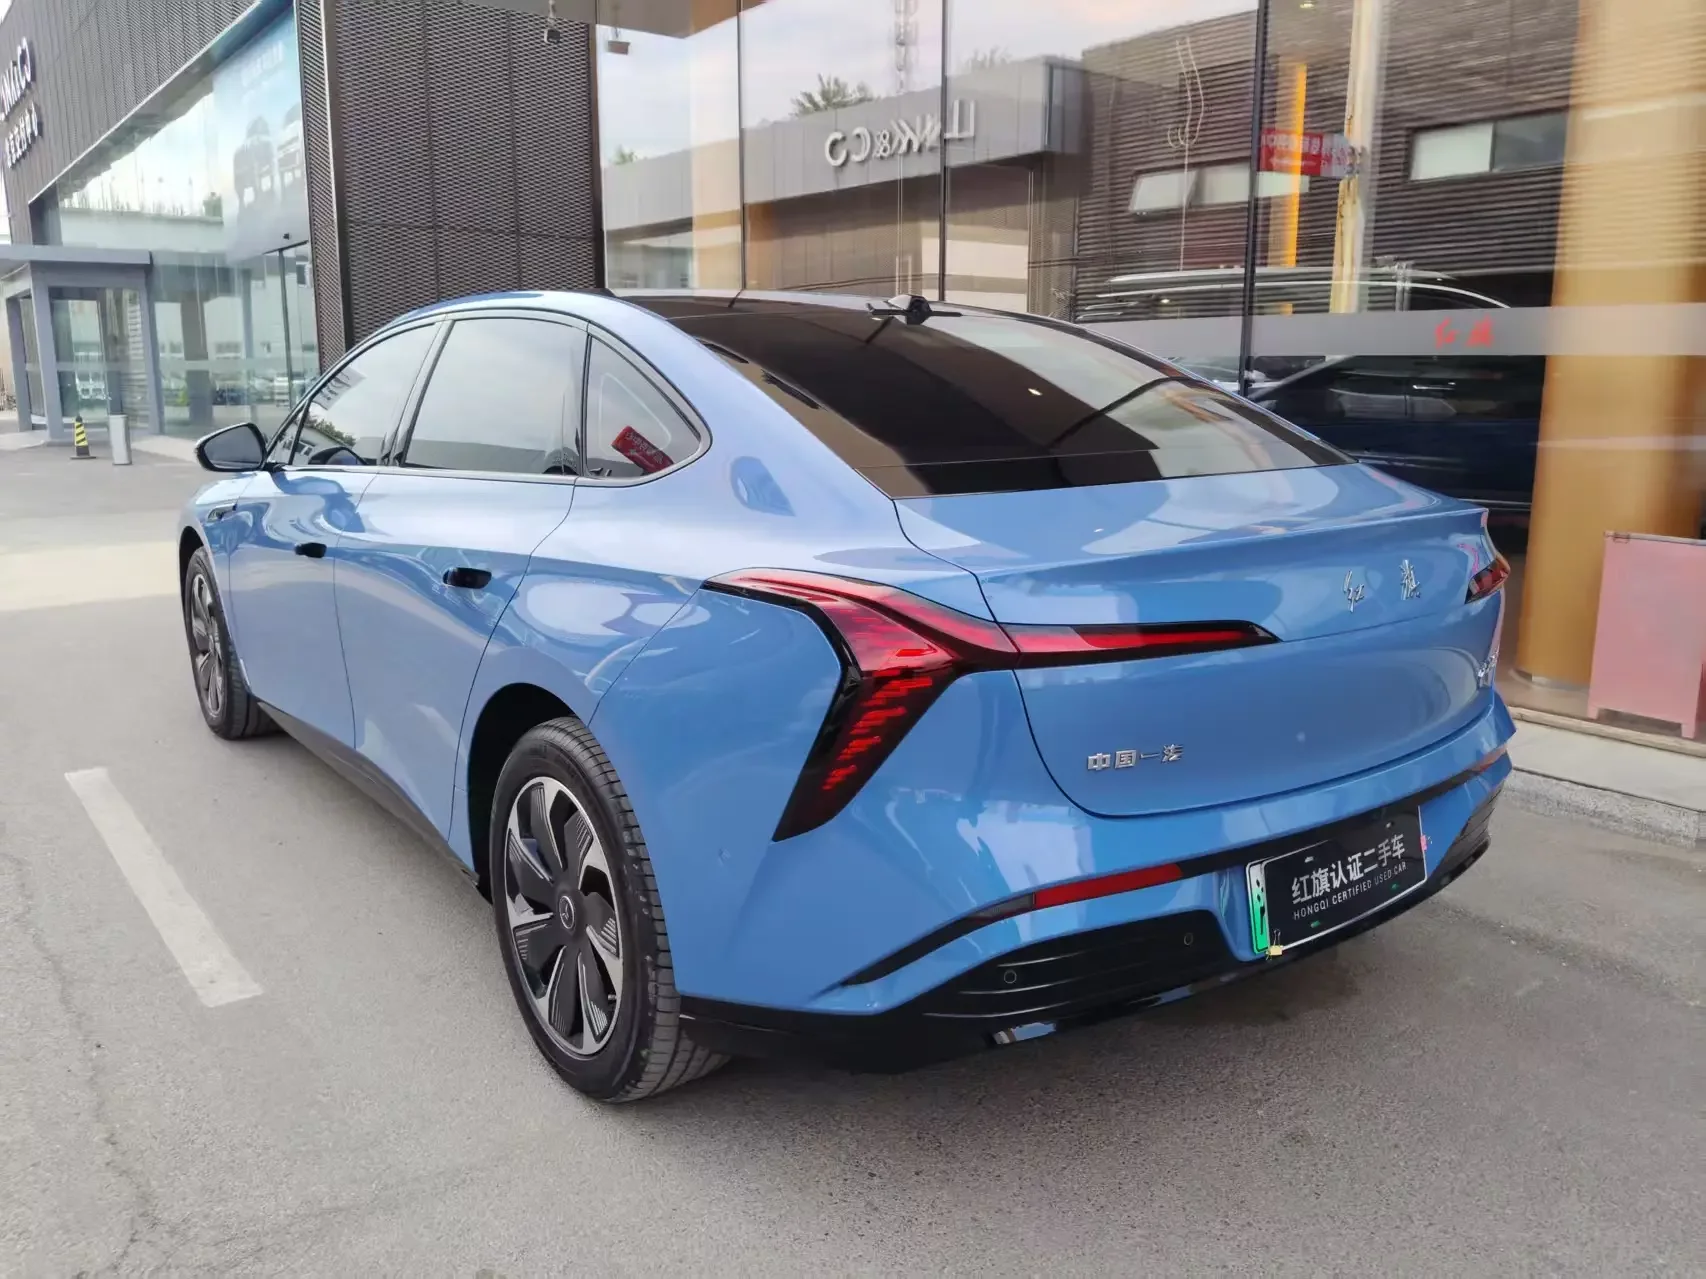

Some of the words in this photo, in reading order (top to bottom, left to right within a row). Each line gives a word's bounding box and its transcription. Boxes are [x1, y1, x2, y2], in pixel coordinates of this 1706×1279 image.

[1087, 743, 1184, 771] 中国一汽
[1291, 833, 1406, 905] 红旗认证二手车
[1293, 897, 1330, 920] HONGQI
[1332, 880, 1372, 905] CERTIFIED
[1374, 868, 1393, 886] USED
[1393, 861, 1407, 875] CAR
